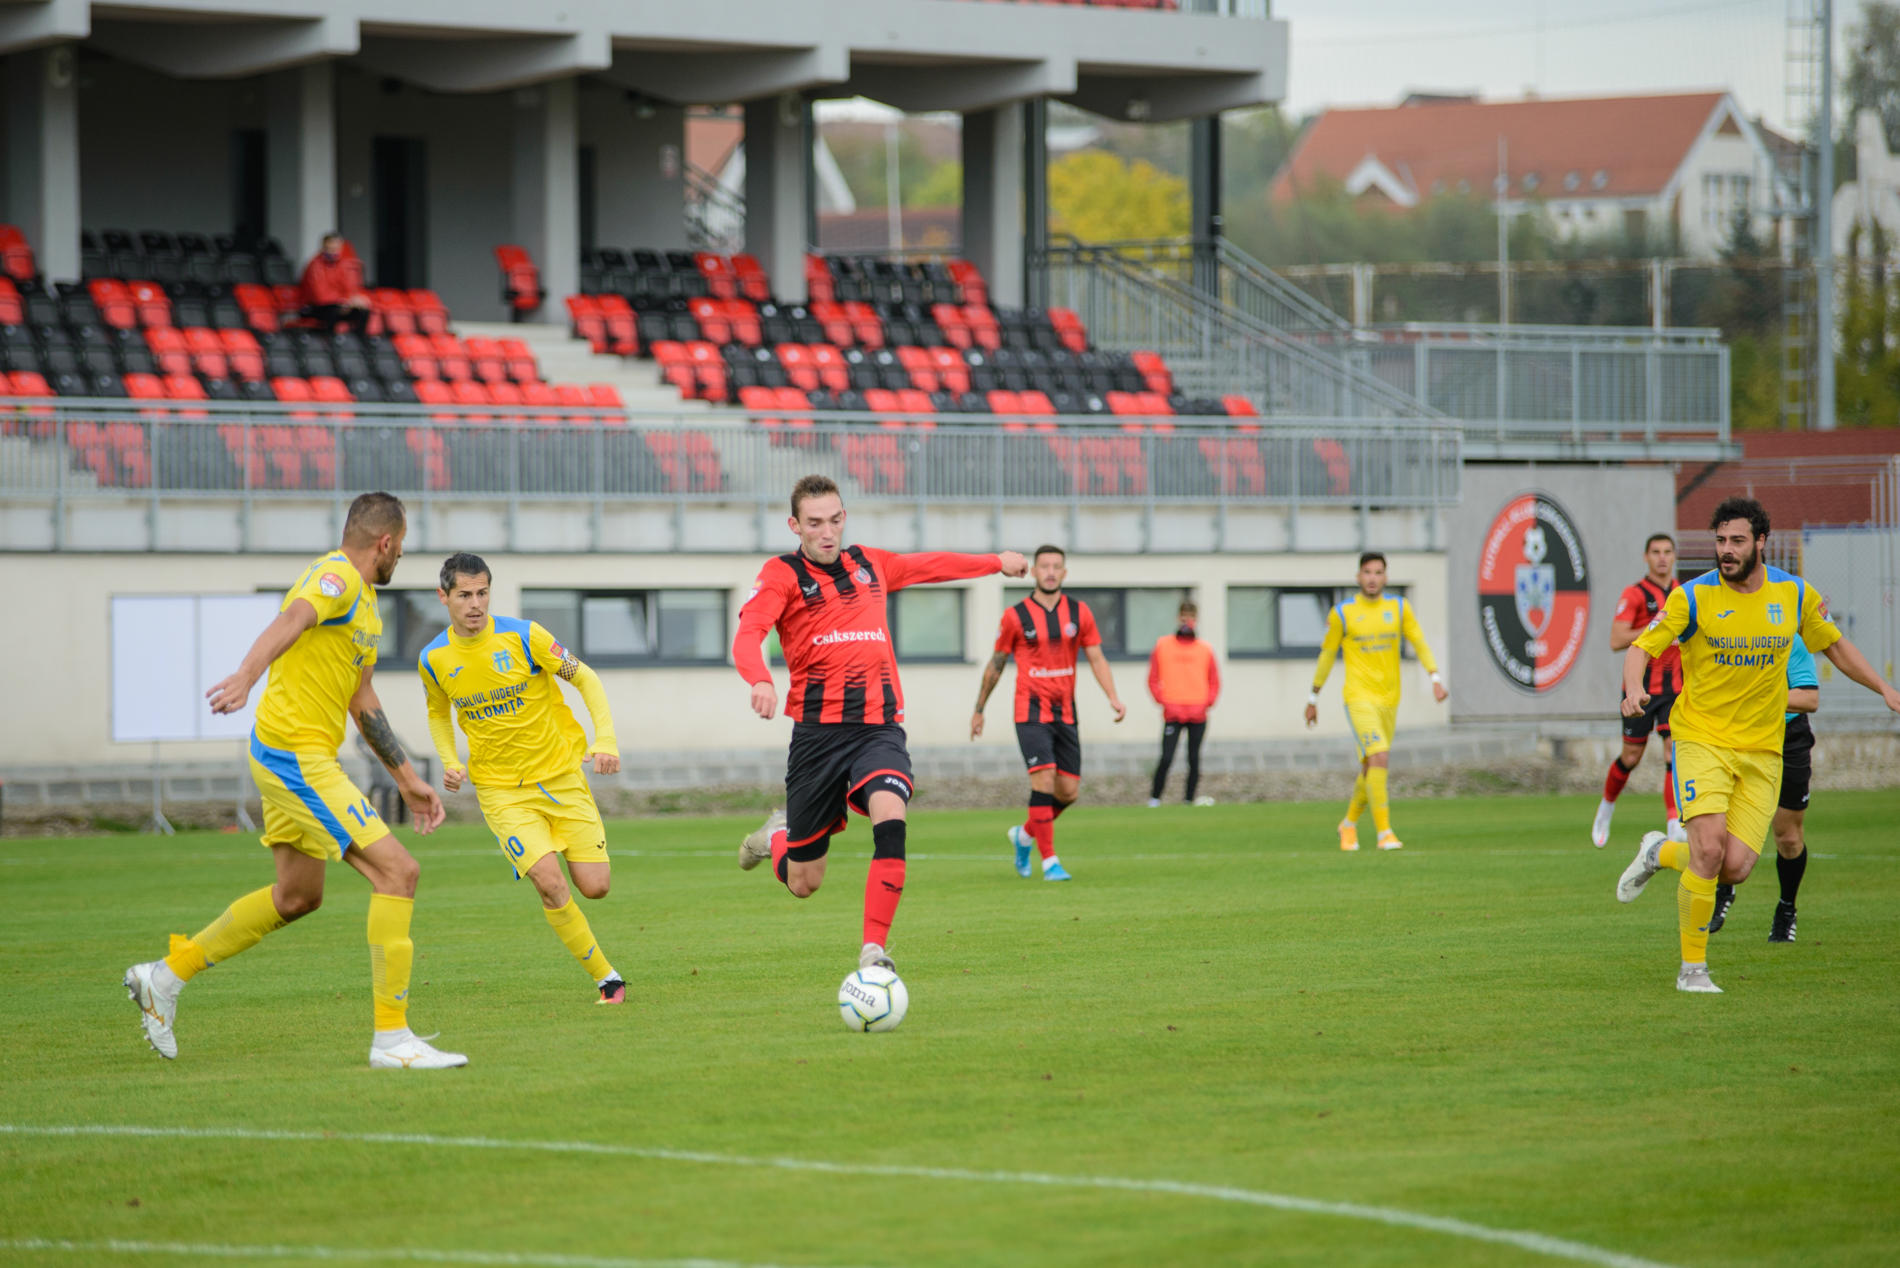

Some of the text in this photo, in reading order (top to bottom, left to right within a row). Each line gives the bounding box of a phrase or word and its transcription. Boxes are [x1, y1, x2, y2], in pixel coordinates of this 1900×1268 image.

[1714, 653, 1774, 670] IALOMIȚA
[1685, 779, 1696, 802] 5
[347, 798, 378, 828] 14
[504, 835, 525, 863] 10
